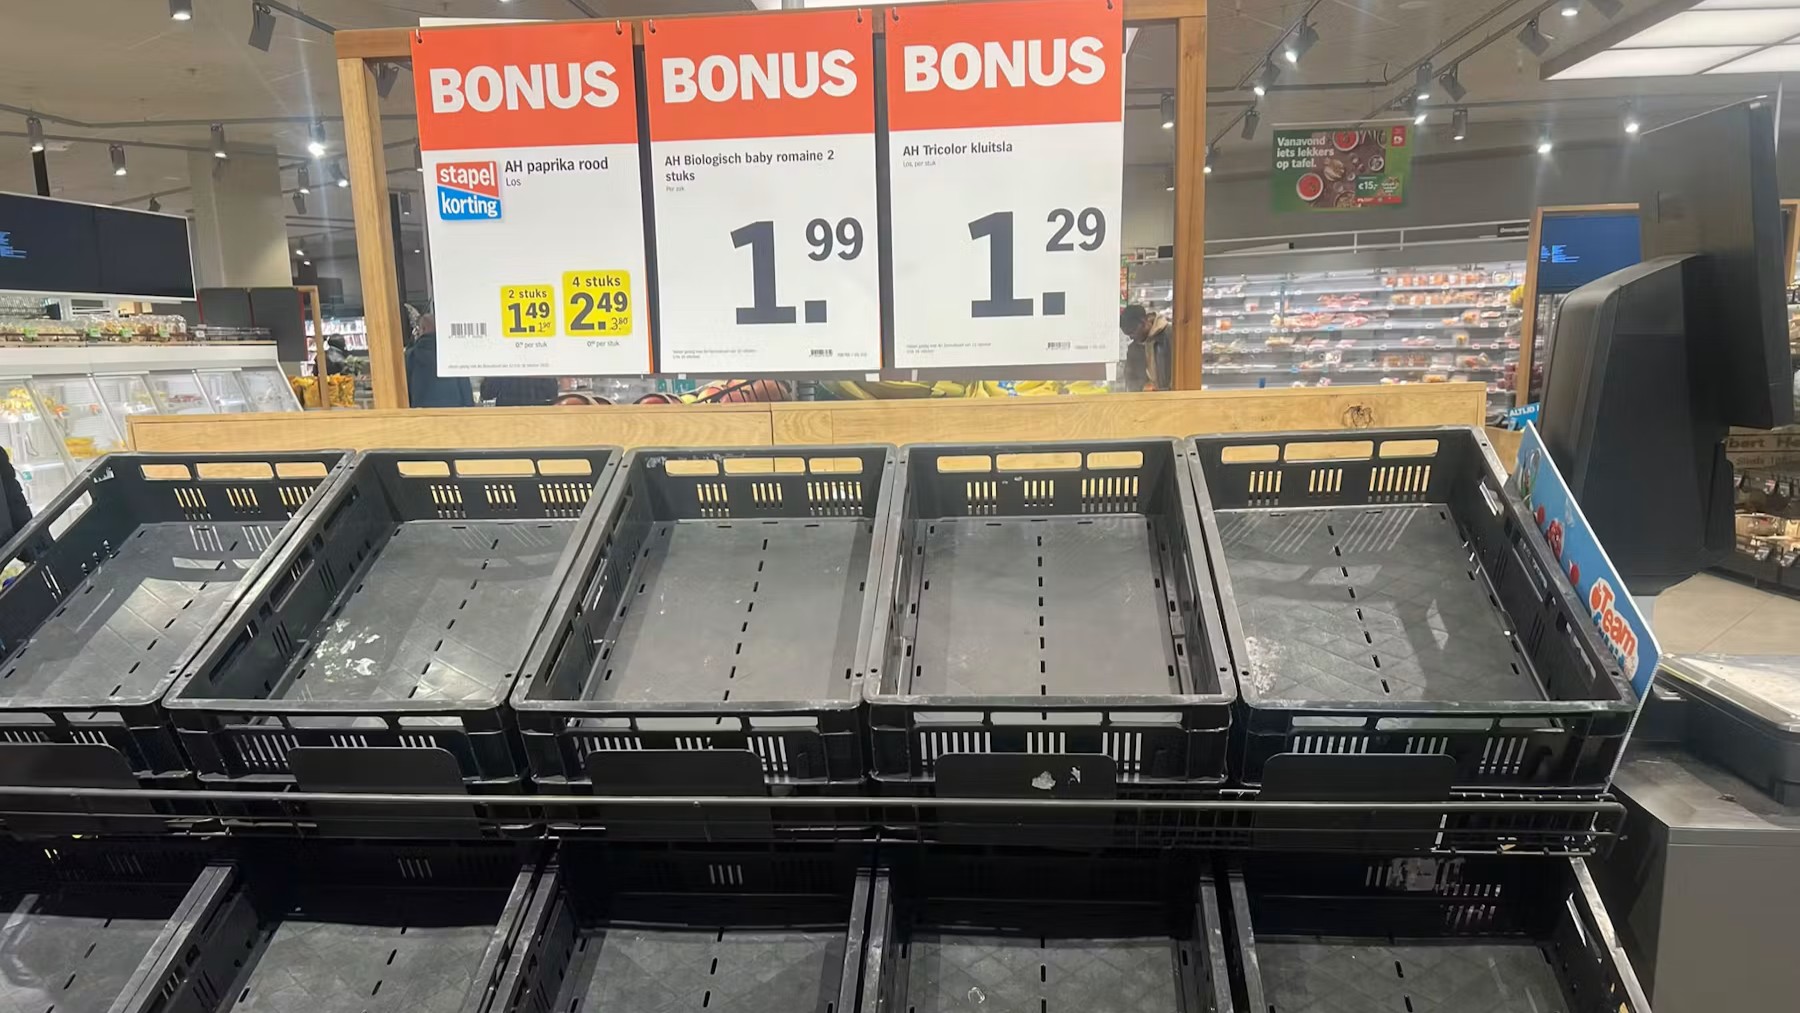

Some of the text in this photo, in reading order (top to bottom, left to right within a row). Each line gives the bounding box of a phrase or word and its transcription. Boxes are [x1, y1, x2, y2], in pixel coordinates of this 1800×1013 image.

[904, 36, 1106, 93] BONUS
[662, 49, 857, 103] BONUS
[430, 61, 619, 113] BONUS
[903, 141, 1013, 156] AH Tricolor kluitsla
[1277, 136, 1326, 147] Vanavond
[665, 150, 835, 167] AH Biologisch baby romaine 2
[1277, 147, 1334, 158] iets lekkers
[505, 157, 608, 174] AH paprika rood
[1276, 161, 1289, 170] op
[440, 162, 495, 189] stapel
[506, 178, 521, 187] Los
[665, 170, 695, 182] stuks
[441, 192, 498, 217] korting
[572, 275, 621, 287] 4 stuks
[509, 288, 547, 298] 2 stuks
[1600, 584, 1636, 657] Team
